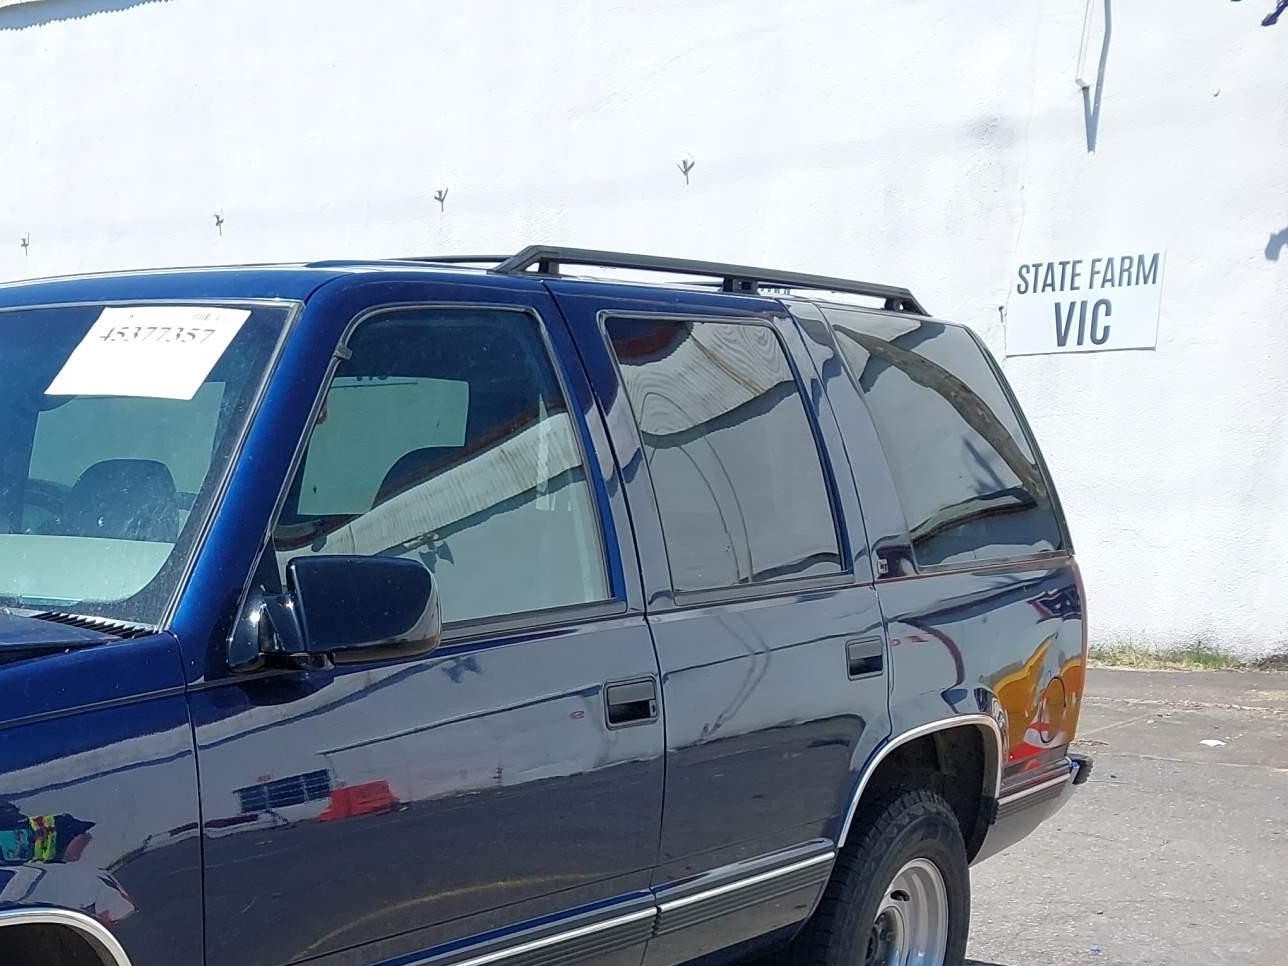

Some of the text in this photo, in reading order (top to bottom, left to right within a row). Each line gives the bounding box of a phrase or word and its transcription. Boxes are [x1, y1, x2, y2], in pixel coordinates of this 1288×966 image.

[1017, 252, 1160, 295] STATE FARM
[99, 326, 216, 344] 45377357
[1054, 298, 1112, 348] VIC
